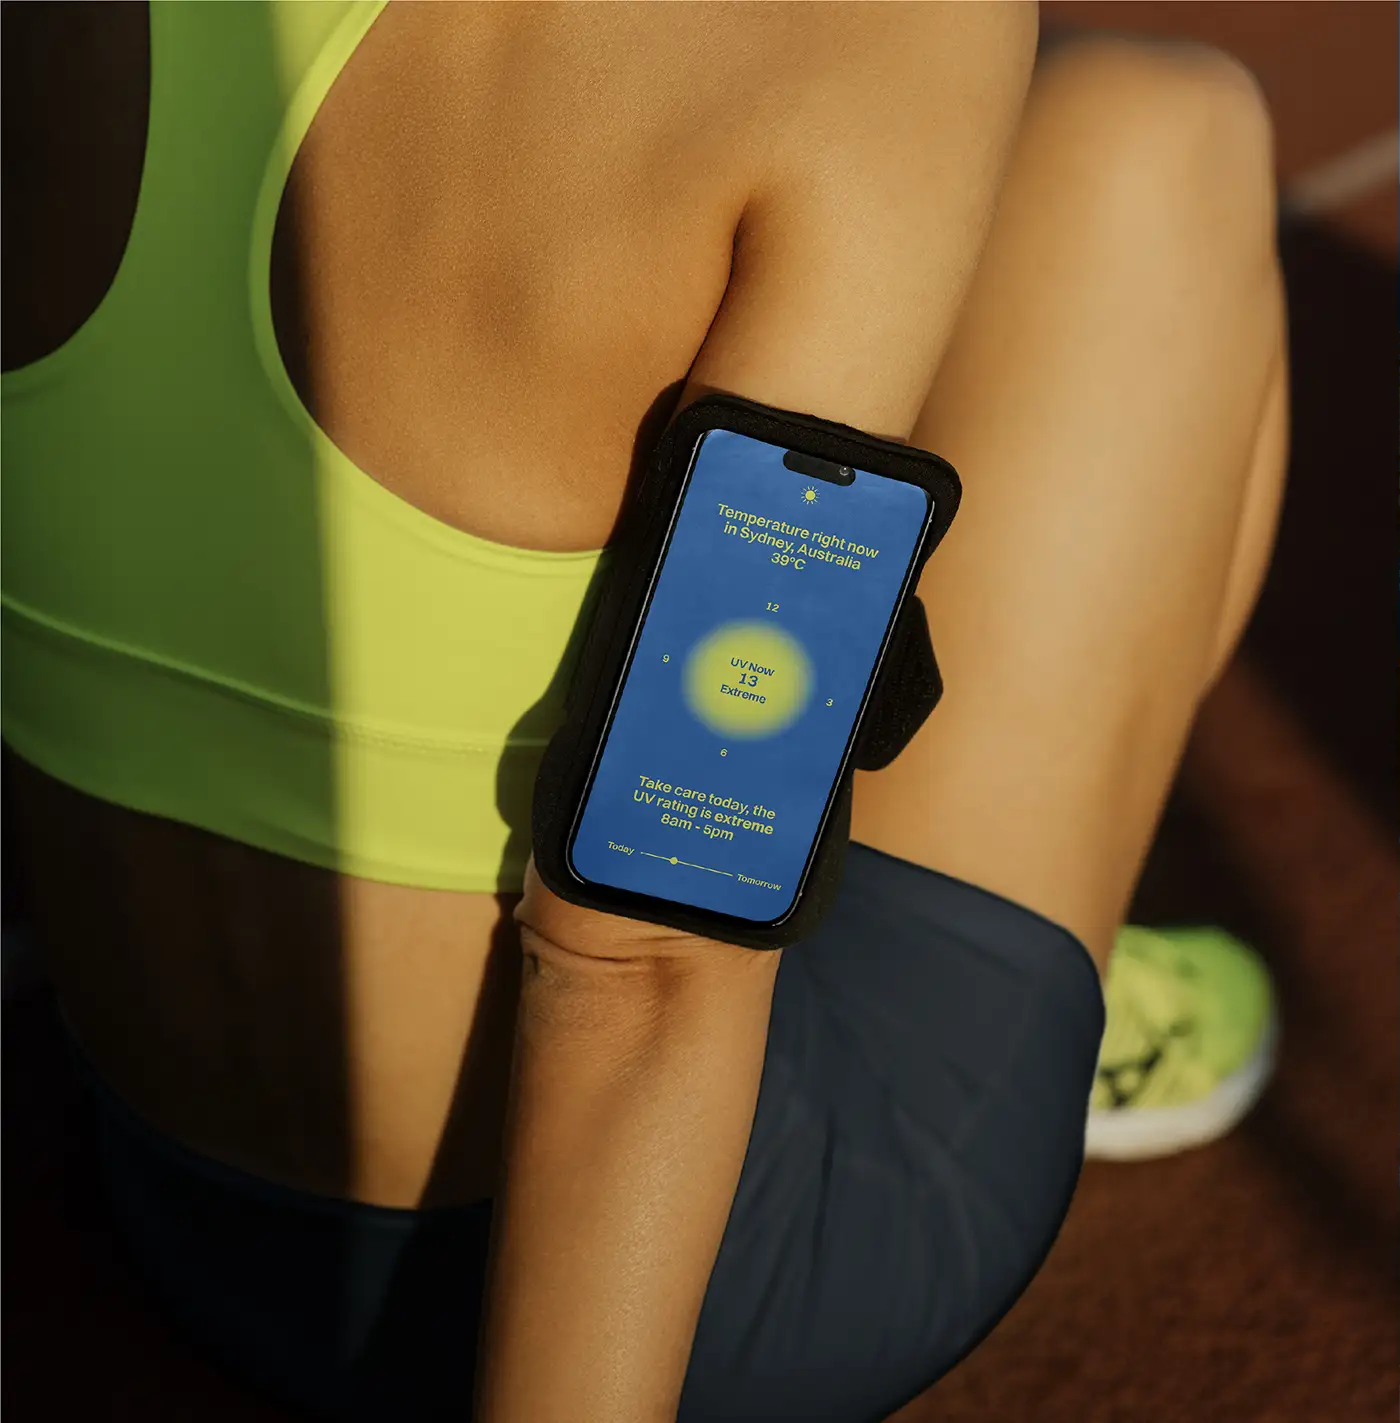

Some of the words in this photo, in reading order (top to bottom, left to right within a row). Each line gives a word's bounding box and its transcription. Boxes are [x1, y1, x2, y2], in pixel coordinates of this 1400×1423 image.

[718, 503, 810, 539] Temperature
[812, 531, 845, 550] right
[847, 541, 879, 559] now
[724, 521, 737, 535] in
[740, 527, 795, 554] Sydney,
[797, 544, 861, 570] Australia
[766, 602, 780, 613] 12
[662, 654, 670, 663] 9
[730, 657, 748, 669] UV
[748, 663, 775, 676] Now
[738, 673, 758, 688] 13
[720, 684, 767, 704] Extreme
[826, 698, 834, 707] 3
[720, 748, 728, 757] 6
[639, 775, 672, 793] Take
[674, 787, 707, 802] care
[709, 793, 749, 815] today,
[753, 805, 776, 820] the
[633, 789, 656, 804] UV
[656, 797, 698, 819] rating
[700, 806, 712, 819] is
[714, 812, 774, 835] extreme
[661, 813, 692, 831] 8am
[703, 824, 734, 841] 5pm
[608, 840, 635, 856] Today
[737, 873, 782, 891] Tomorrow
